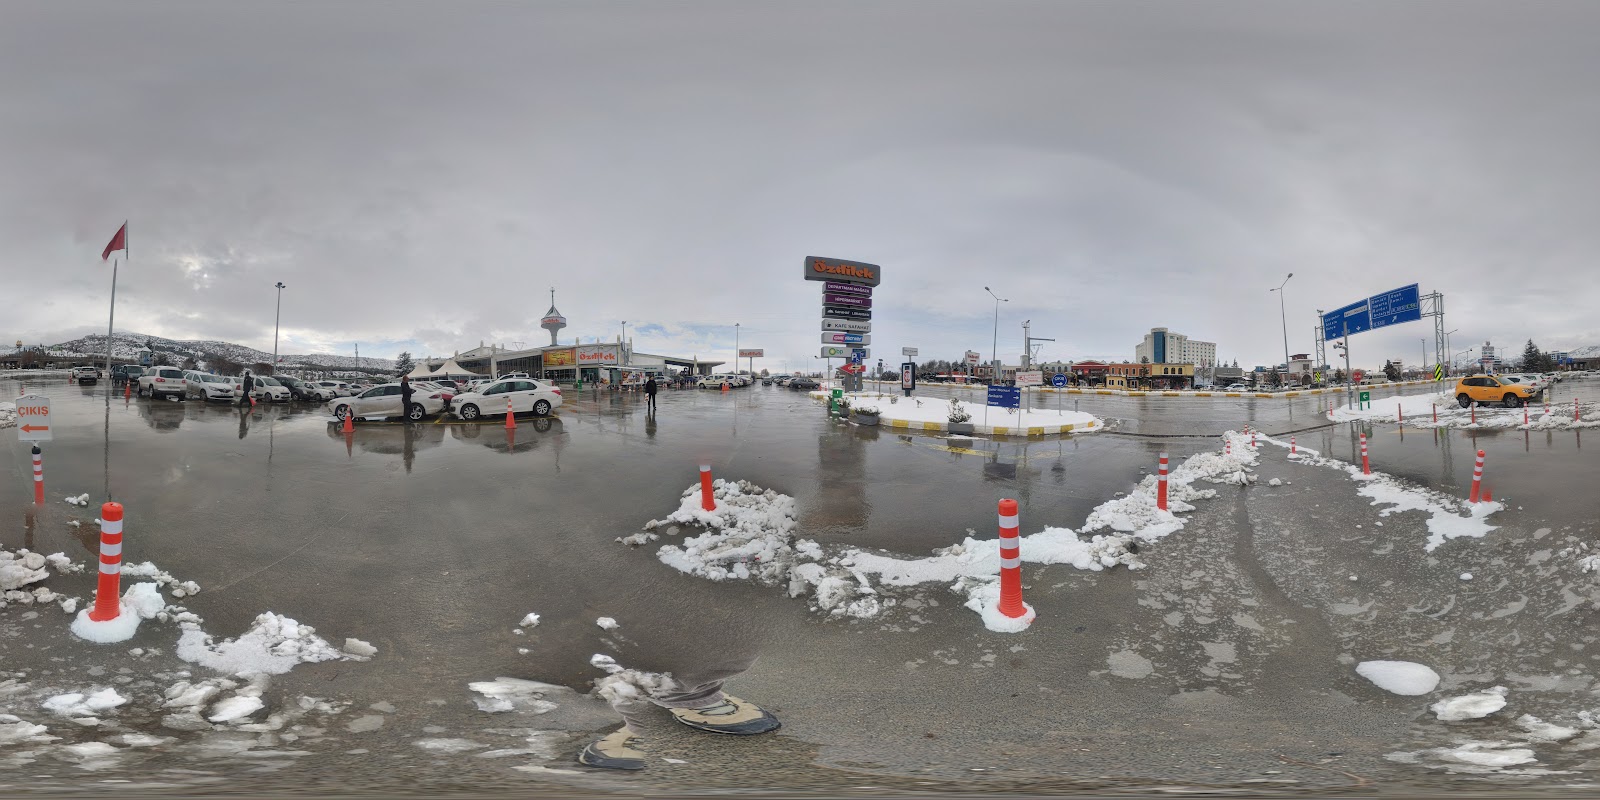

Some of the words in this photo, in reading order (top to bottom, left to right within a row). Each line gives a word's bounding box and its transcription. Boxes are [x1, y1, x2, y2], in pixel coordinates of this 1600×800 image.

[813, 259, 875, 279] Özdilek
[580, 352, 616, 360] Özdilek
[18, 406, 48, 417] ÇIKIŞ
